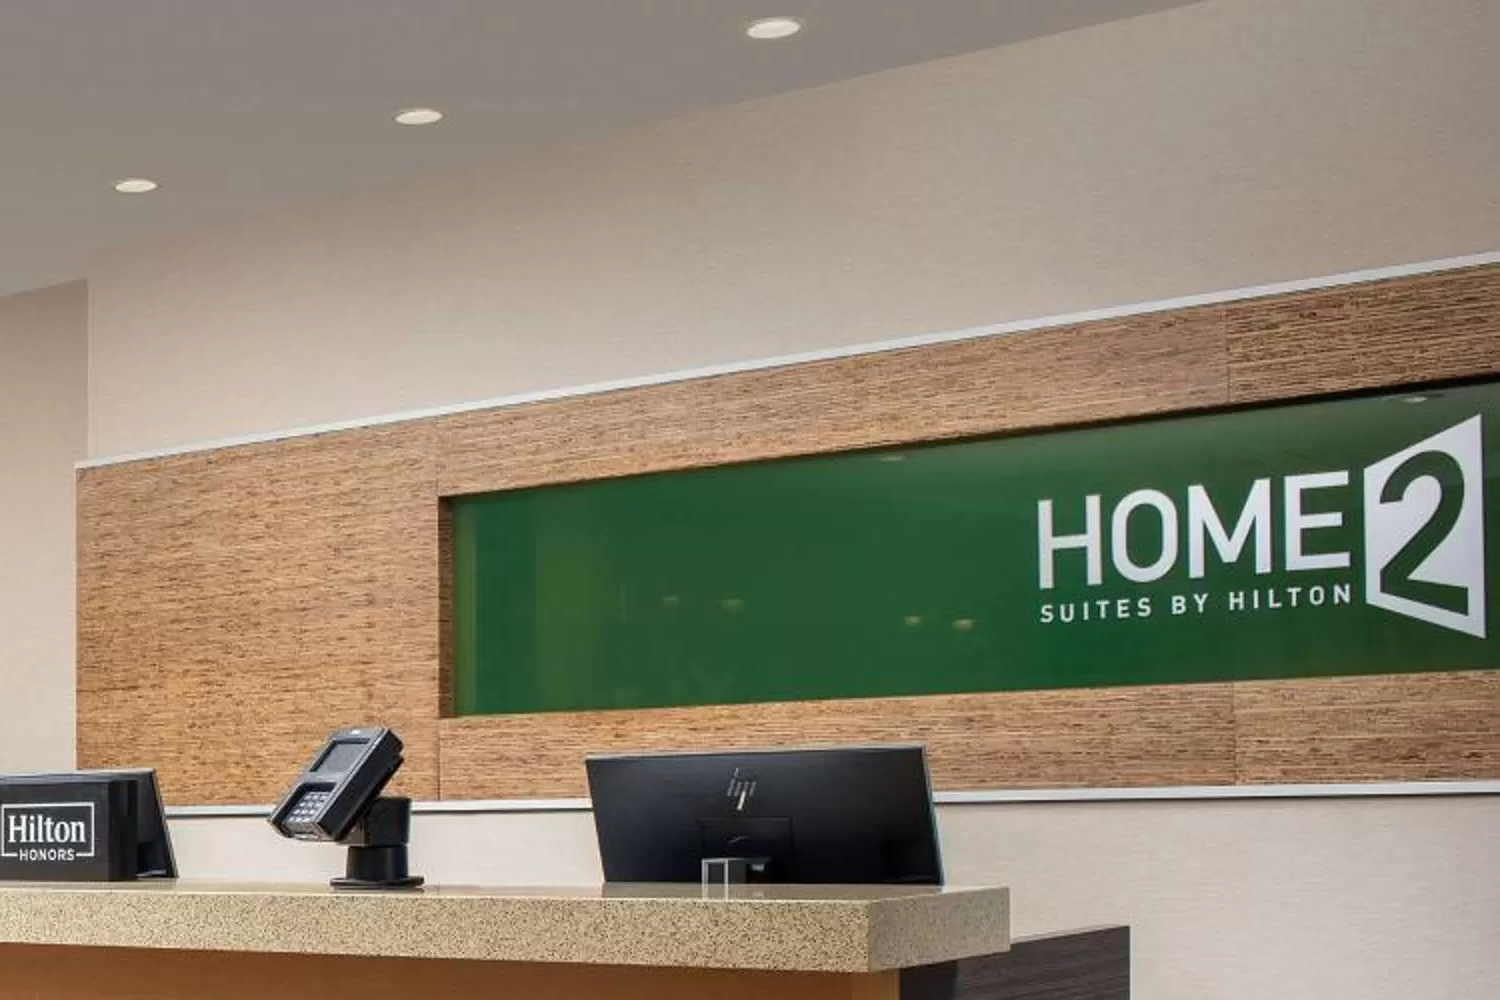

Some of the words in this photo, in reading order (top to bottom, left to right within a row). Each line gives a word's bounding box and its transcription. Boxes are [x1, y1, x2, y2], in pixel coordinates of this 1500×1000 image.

[1040, 597, 1152, 623] SUITES
[1172, 593, 1209, 615] BY
[1229, 584, 1351, 610] HILTON
[7, 814, 87, 843] Hilton
[19, 848, 75, 861] HONORS
